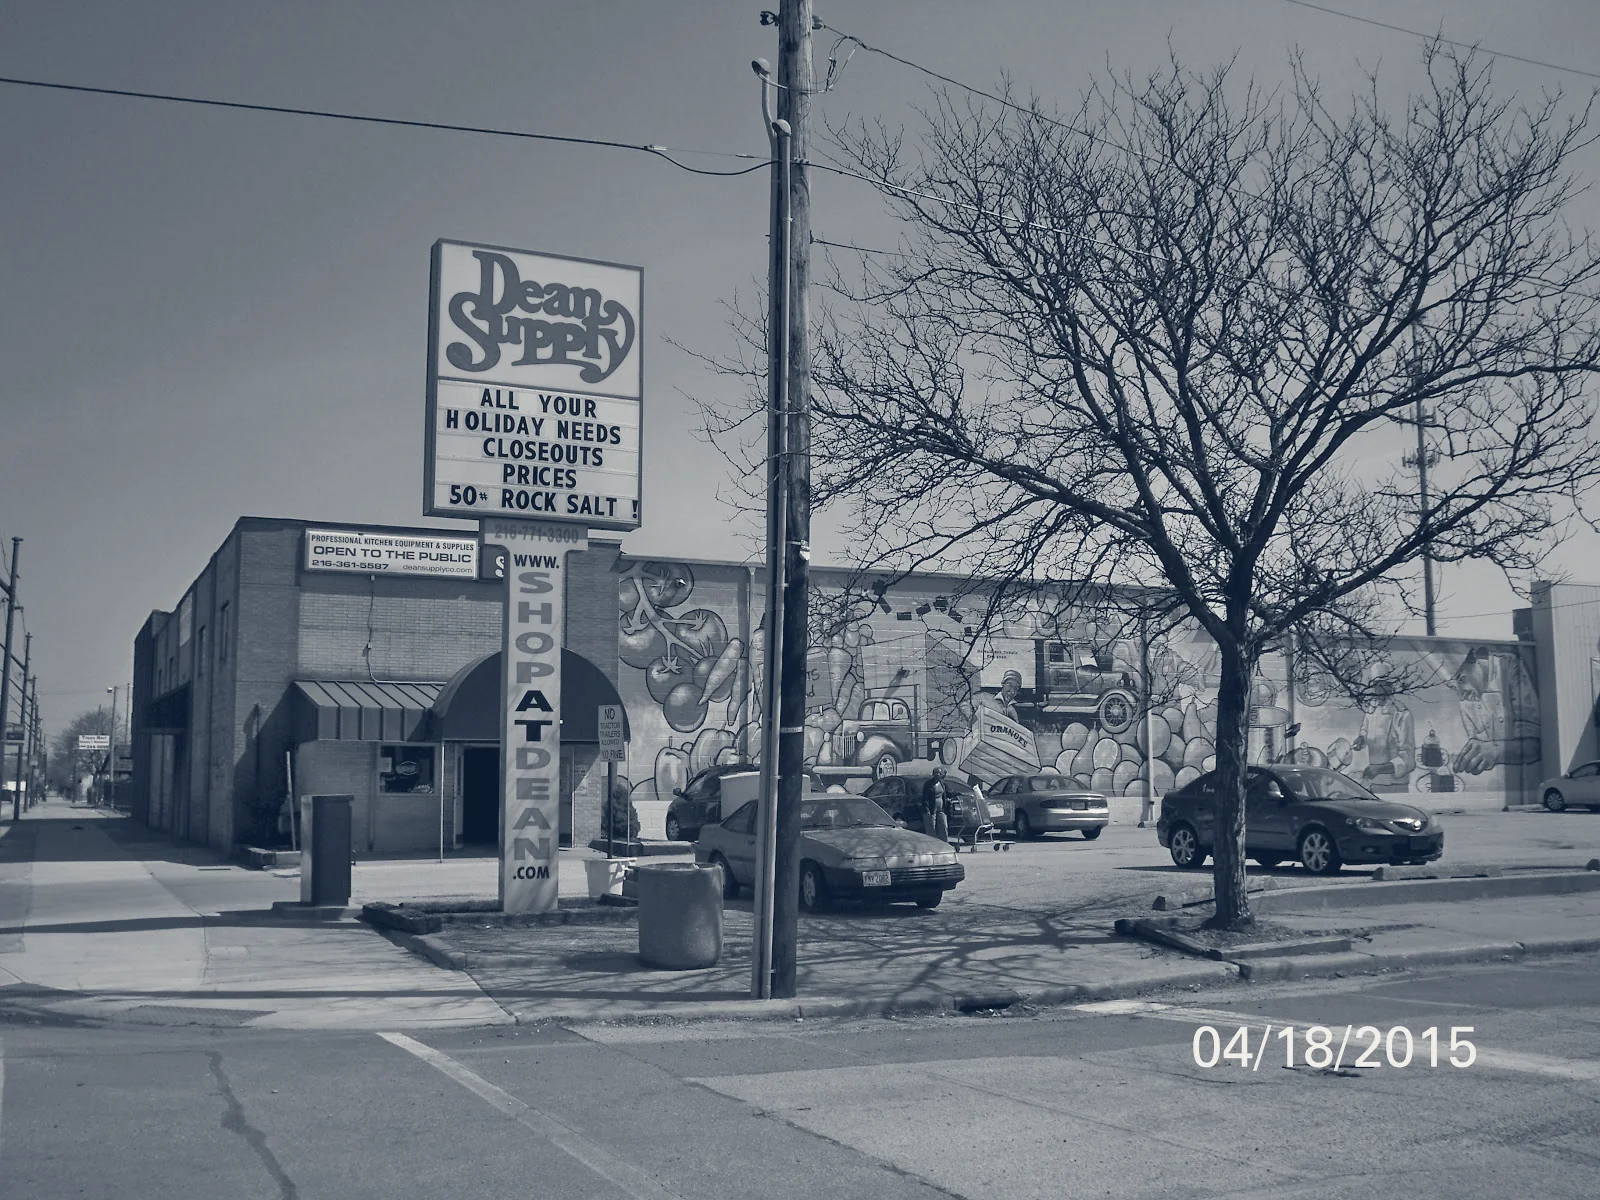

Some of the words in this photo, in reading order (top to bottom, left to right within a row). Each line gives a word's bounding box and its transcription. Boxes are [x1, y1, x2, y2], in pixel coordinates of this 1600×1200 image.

[472, 250, 602, 319] Dean
[446, 291, 635, 384] Supply
[480, 388, 520, 410] ALL
[538, 394, 597, 418] YOUR
[446, 409, 545, 437] HOLIDAY
[557, 420, 621, 445] NEEDS
[483, 437, 603, 467] CLOSEOUTS
[503, 463, 577, 489] PRICES
[501, 490, 557, 512] ROCK
[567, 495, 617, 517] SALT
[311, 535, 363, 545] PROFESSIONAL
[364, 538, 393, 546] KITCHEN
[395, 540, 434, 549] EQUIPMENT
[443, 542, 474, 551] SUPPLIES
[313, 545, 357, 557] OPEN
[360, 548, 382, 558] TO
[385, 550, 415, 560] THE
[418, 551, 471, 563] PUBLIC
[312, 559, 389, 570] 216-361-5587
[402, 564, 473, 574] deansupplyco.com
[604, 708, 616, 720] NO
[600, 722, 621, 730] TRACTOR
[600, 730, 621, 738] TRAILERS
[990, 725, 1027, 748] ORANGES
[610, 749, 624, 759] FINE
[512, 866, 550, 880] .COM
